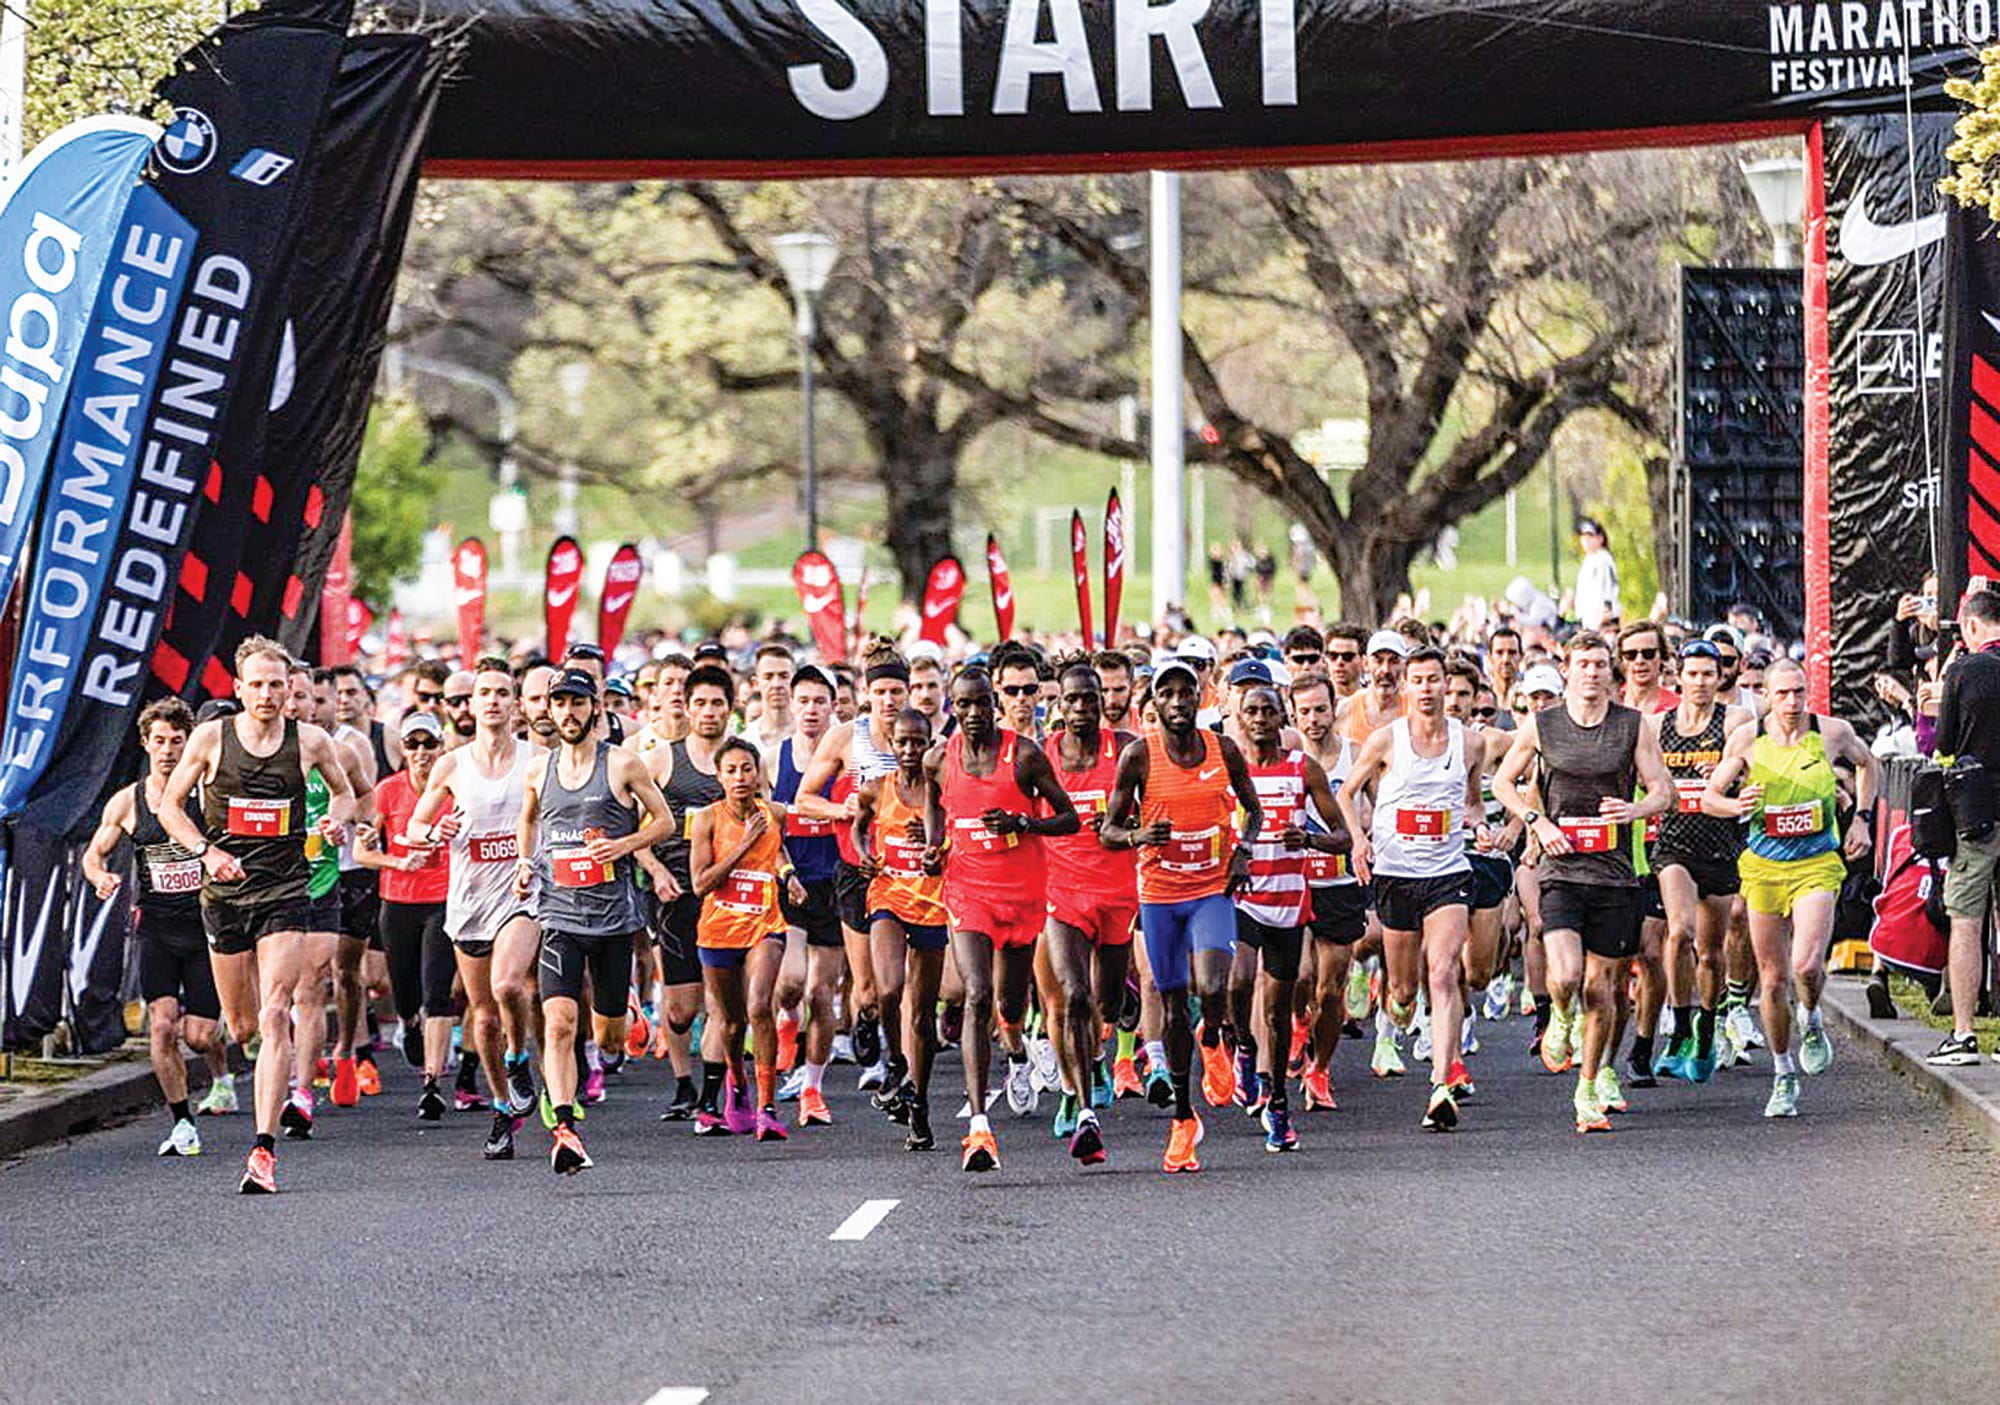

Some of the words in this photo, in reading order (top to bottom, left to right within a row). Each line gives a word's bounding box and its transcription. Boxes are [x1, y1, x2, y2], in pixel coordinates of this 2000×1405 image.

[1769, 0, 2000, 53] MARATHO
[1771, 54, 1914, 93] FESTIVAL
[82, 253, 251, 707] REDEFINED
[0, 224, 183, 790] ERFORMANCE
[1777, 813, 1813, 833] 5525
[480, 838, 518, 860] 5069
[158, 870, 199, 890] 12908
